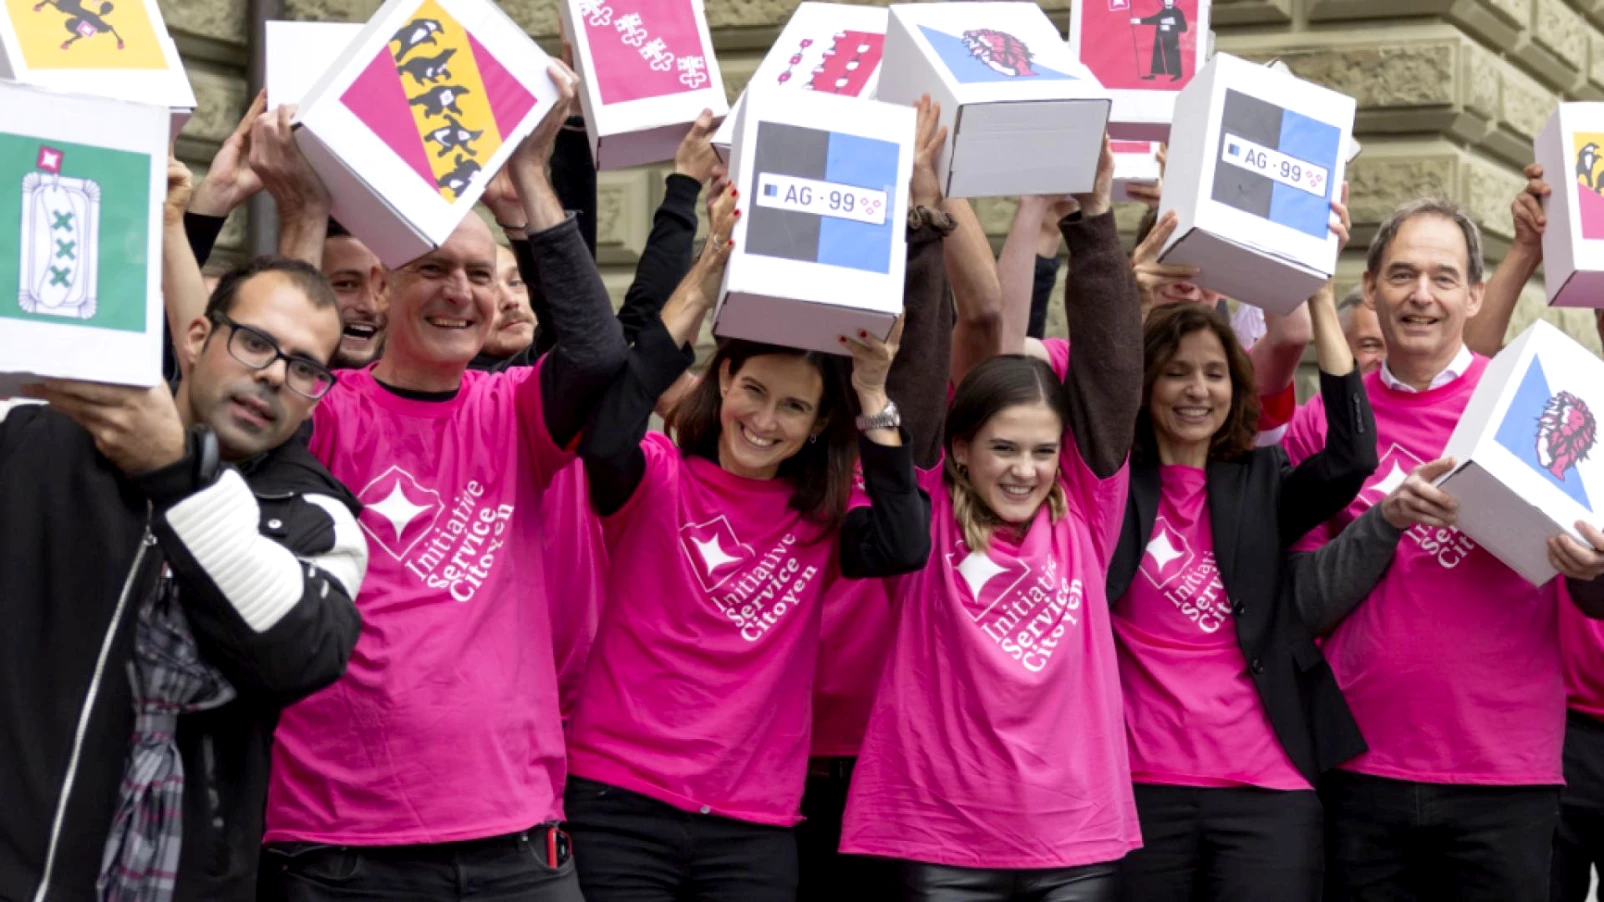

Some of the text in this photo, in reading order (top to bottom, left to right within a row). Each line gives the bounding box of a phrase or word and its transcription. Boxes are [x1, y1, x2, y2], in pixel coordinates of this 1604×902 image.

[784, 184, 812, 206] AG
[828, 190, 855, 213] 99
[1244, 148, 1267, 169] AG
[1280, 160, 1302, 182] 99
[404, 480, 485, 582] Initiative
[427, 507, 497, 588] Service
[449, 503, 515, 602] Citoyen
[711, 533, 796, 612] Initiative
[726, 557, 800, 628] Service
[741, 565, 818, 642] Citoyen
[1001, 577, 1069, 660] Service
[1022, 578, 1083, 672] Citoyen
